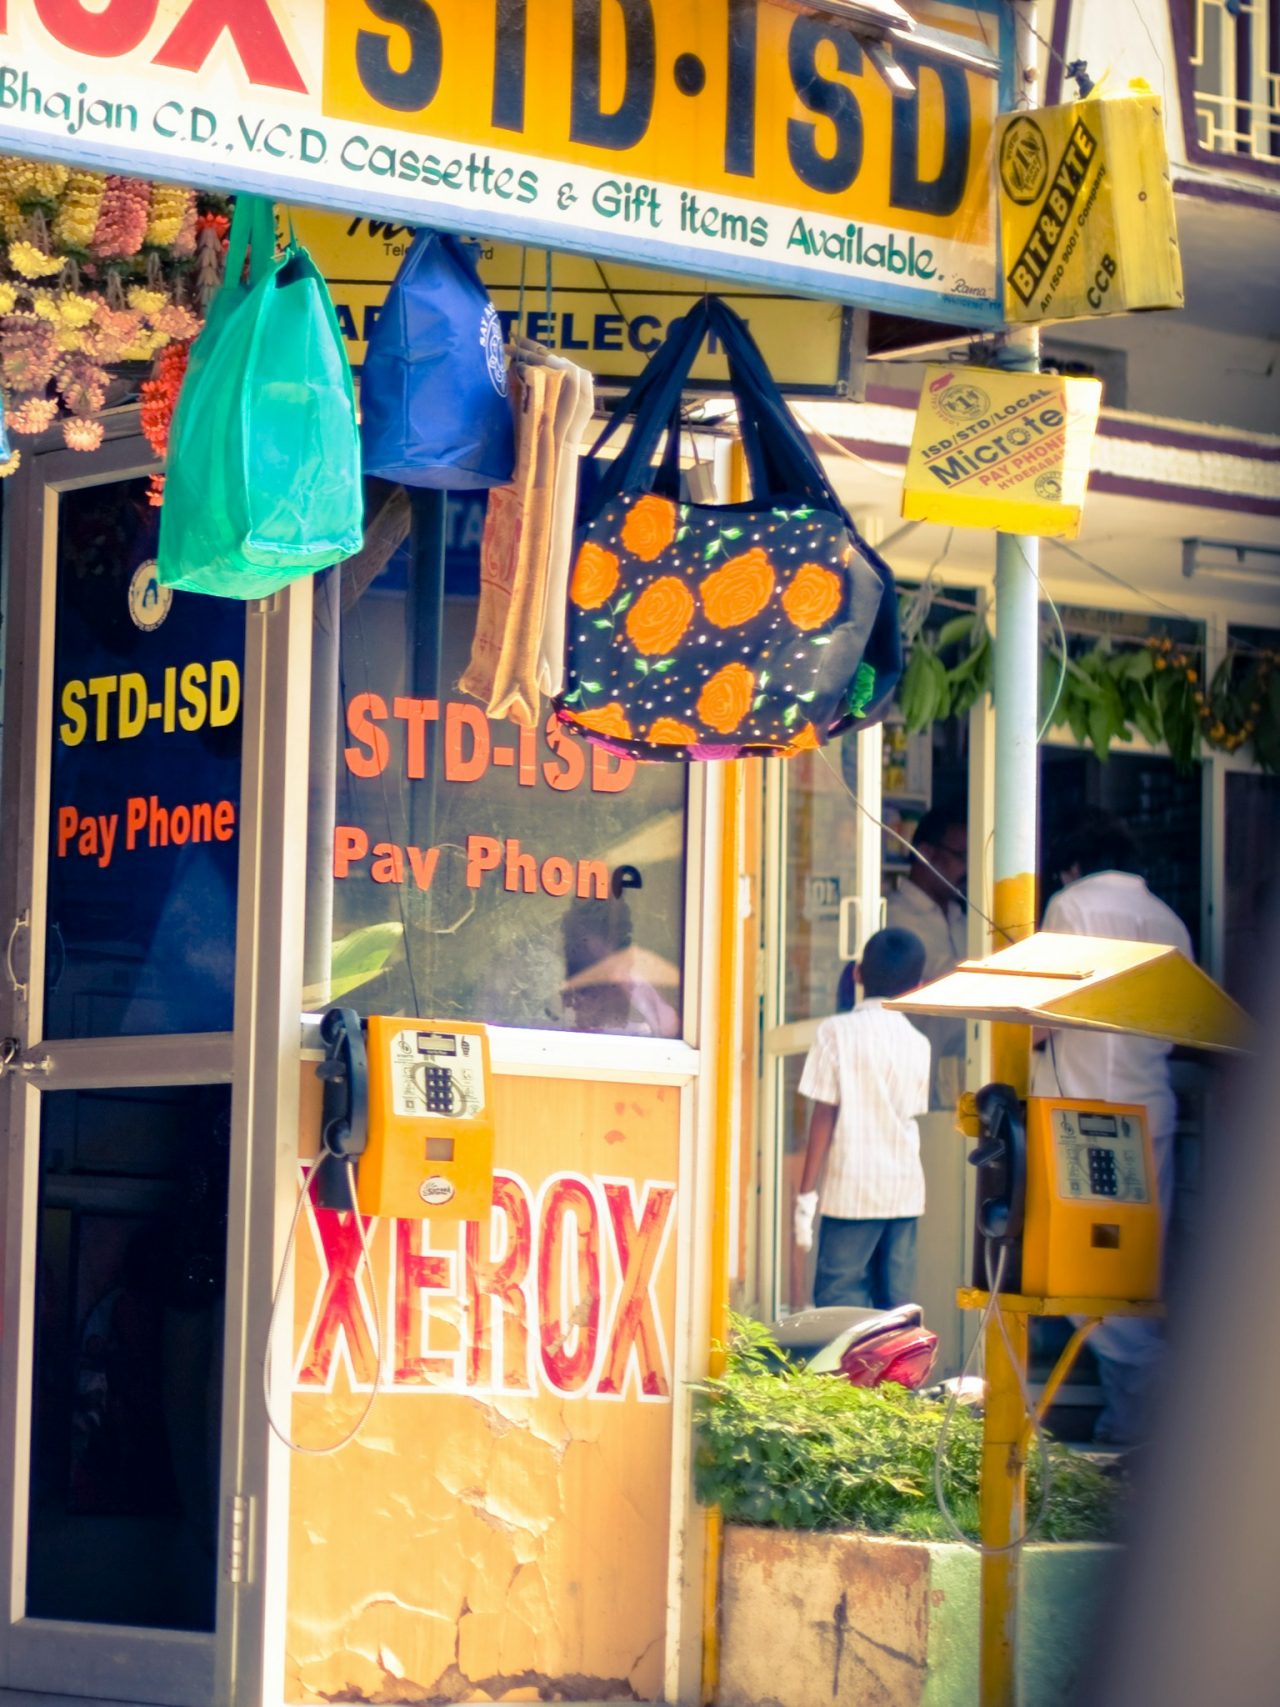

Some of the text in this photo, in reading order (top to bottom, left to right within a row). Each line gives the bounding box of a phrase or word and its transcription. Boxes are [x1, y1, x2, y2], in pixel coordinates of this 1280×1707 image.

[340, 135, 539, 204] Cassettes
[557, 182, 579, 211] &
[592, 180, 663, 228] Gift
[680, 191, 768, 247] items
[786, 216, 945, 281] Available.
[1040, 162, 1107, 313] An ISO 9001 Company
[1085, 253, 1118, 310] CCB
[978, 464, 1010, 487] PAY
[60, 659, 240, 747] STD-ISD
[57, 795, 235, 869] Pay Phone
[293, 1164, 676, 1402] XEROX
